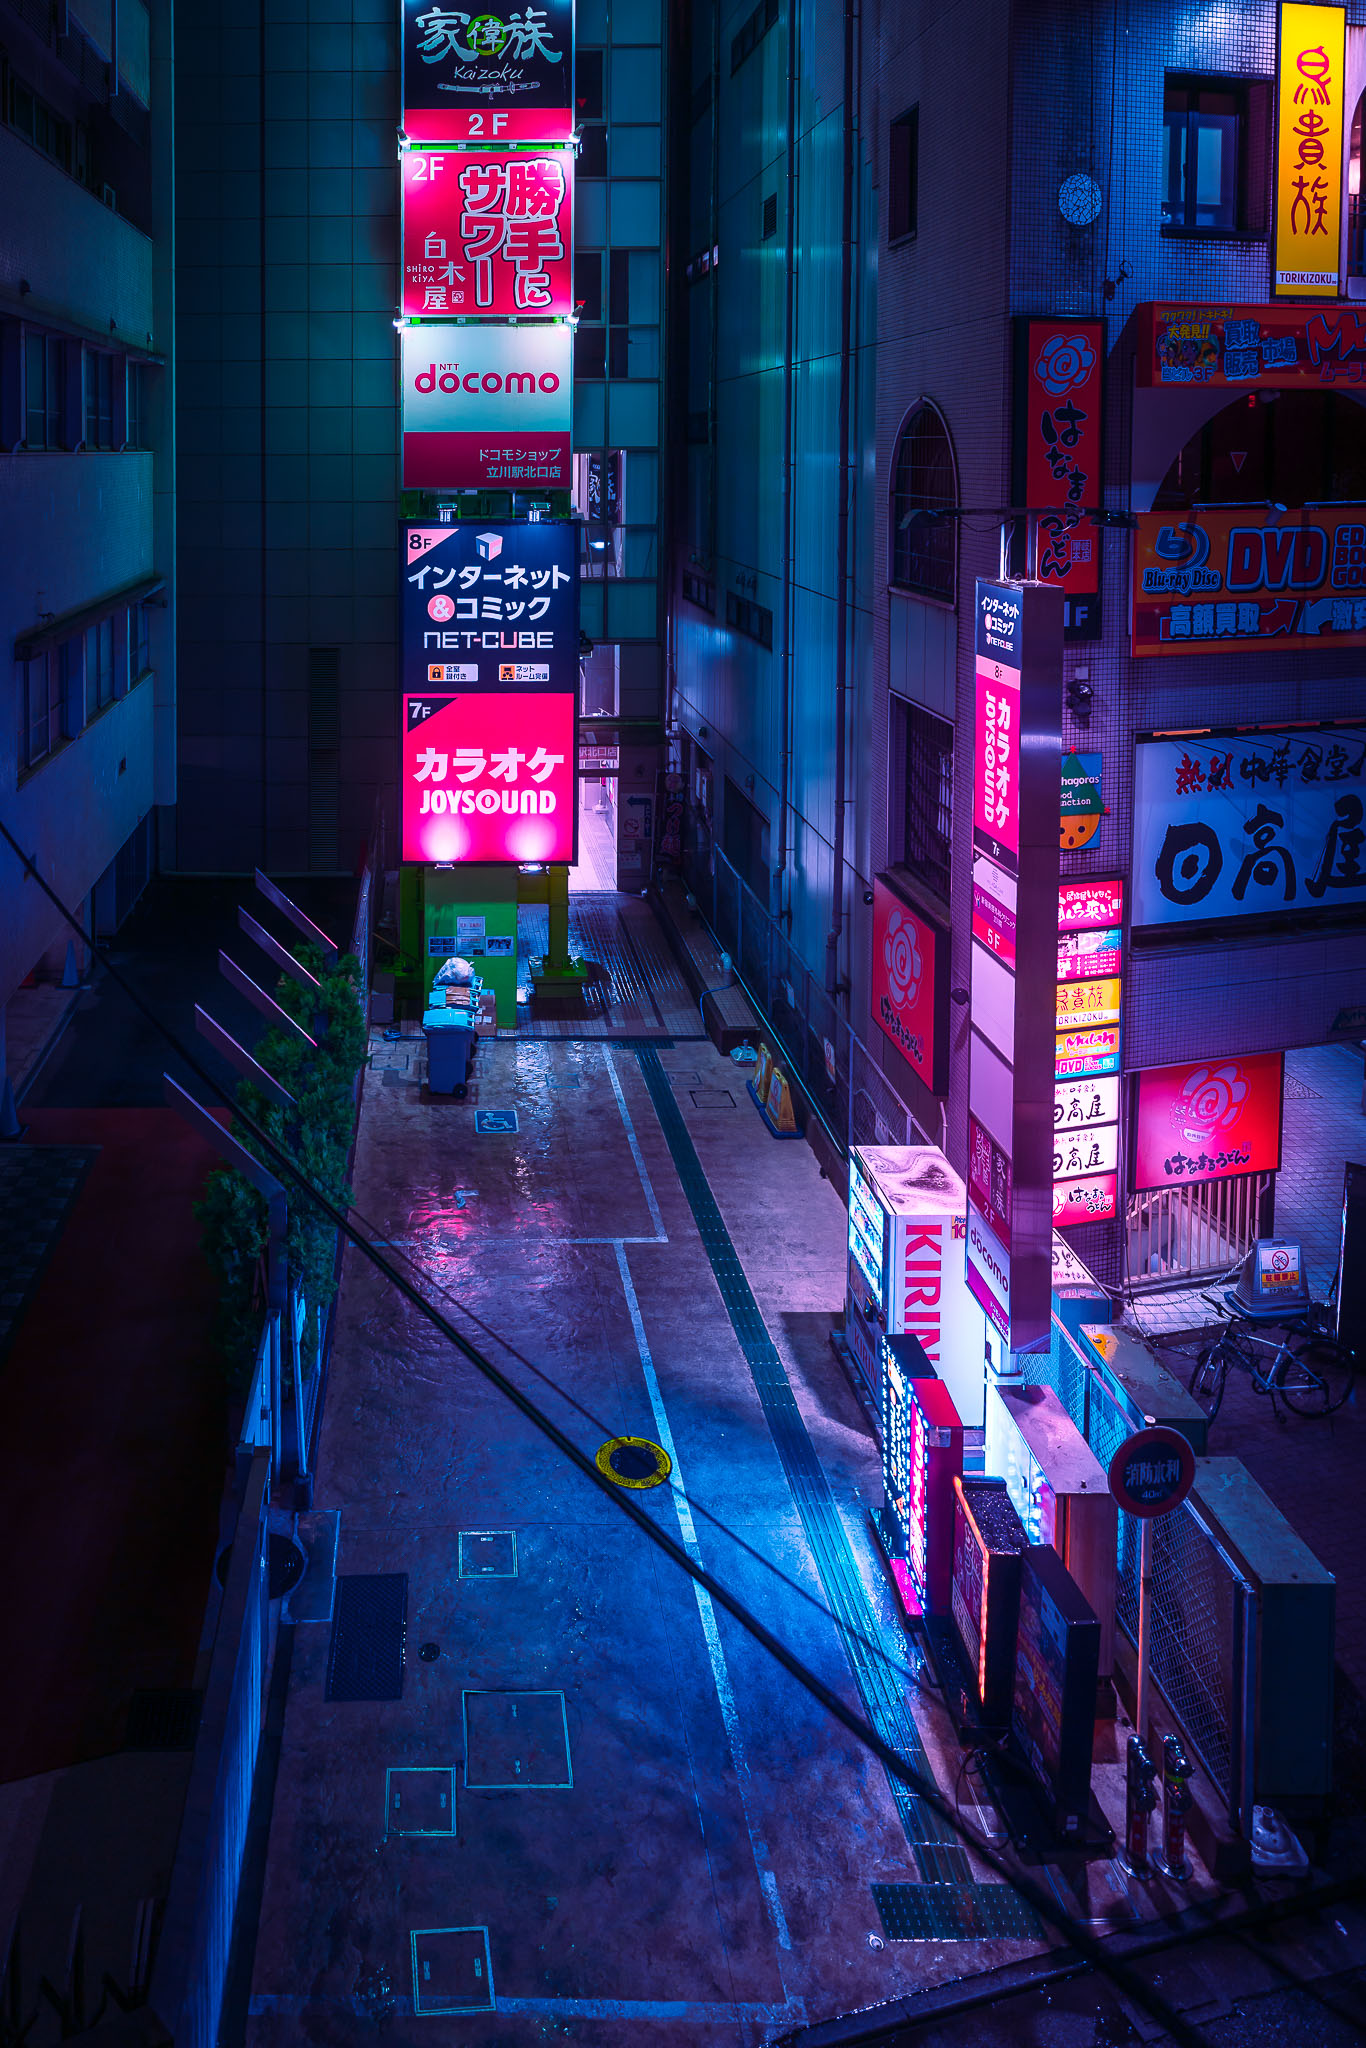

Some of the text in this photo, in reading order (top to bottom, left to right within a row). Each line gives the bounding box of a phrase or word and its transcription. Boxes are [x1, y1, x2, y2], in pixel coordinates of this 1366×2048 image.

[454, 63, 523, 80] Kaizoku
[1291, 45, 1332, 236] 鳥貴族
[411, 157, 445, 181] 2F
[458, 165, 508, 308] サワー
[502, 159, 566, 309] 勝手に
[1279, 272, 1332, 285] TORIKIZOKU
[1167, 322, 1211, 340] 大発見!!
[1305, 312, 1366, 366] M
[414, 363, 561, 394] docomo
[439, 363, 460, 371] NTT
[1320, 361, 1366, 383] ムーラ
[479, 447, 562, 462] ドコモショップ
[486, 465, 562, 479] 立川駅北口店
[1040, 399, 1089, 579] はなまるうどん
[409, 533, 433, 550] 8F
[1226, 525, 1330, 593] DVD
[1334, 546, 1366, 566] BO
[407, 564, 571, 590] インターネット
[1142, 567, 1221, 596] Blu-ray Disc
[432, 596, 551, 621] &コミック
[981, 596, 1020, 619] インターネット
[1169, 602, 1261, 637] 高額買取
[423, 631, 554, 649] NET-CUBE
[516, 665, 536, 673] ネット
[409, 702, 431, 719] 7F
[413, 746, 565, 783] カラオケ
[984, 690, 996, 823] JOYSOUND
[995, 697, 1011, 829] カラオケ
[419, 788, 557, 815] JOYSOUND
[1060, 790, 1073, 799] od
[987, 928, 1001, 949] 5F
[1056, 1011, 1104, 1025] ORIKIZOKU
[1065, 1030, 1116, 1053] Mulan
[1059, 1058, 1084, 1074] DVD
[1163, 1149, 1251, 1176] はなまるうどん
[1068, 1186, 1105, 1204] はなまる
[983, 1200, 995, 1223] 2F
[1086, 1201, 1112, 1213] うどん
[970, 1227, 1009, 1293] docomo
[1124, 1457, 1181, 1488] 消防水利
